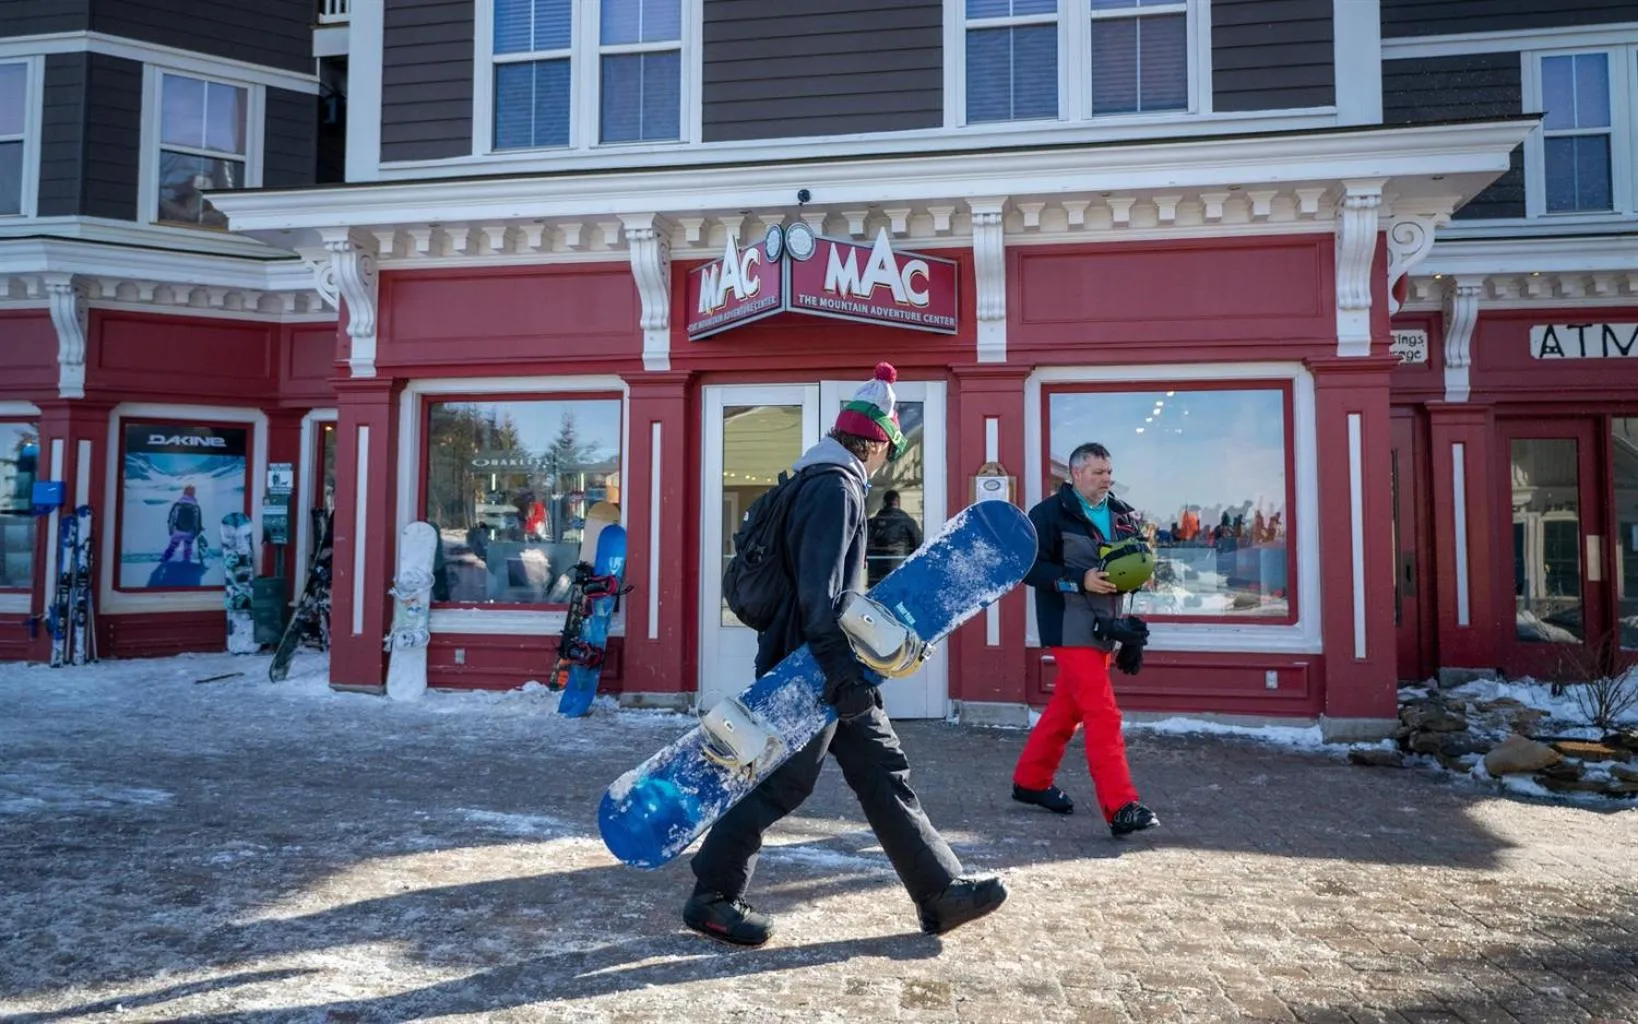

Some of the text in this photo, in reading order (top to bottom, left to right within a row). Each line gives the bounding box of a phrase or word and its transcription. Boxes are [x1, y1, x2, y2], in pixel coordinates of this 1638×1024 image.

[698, 231, 761, 316] MAC
[823, 226, 930, 308] MAC
[799, 294, 955, 326] THE MOUNTAIN ADVENTURE CENTER
[1539, 323, 1638, 358] ATM
[147, 434, 227, 448] DAKINE
